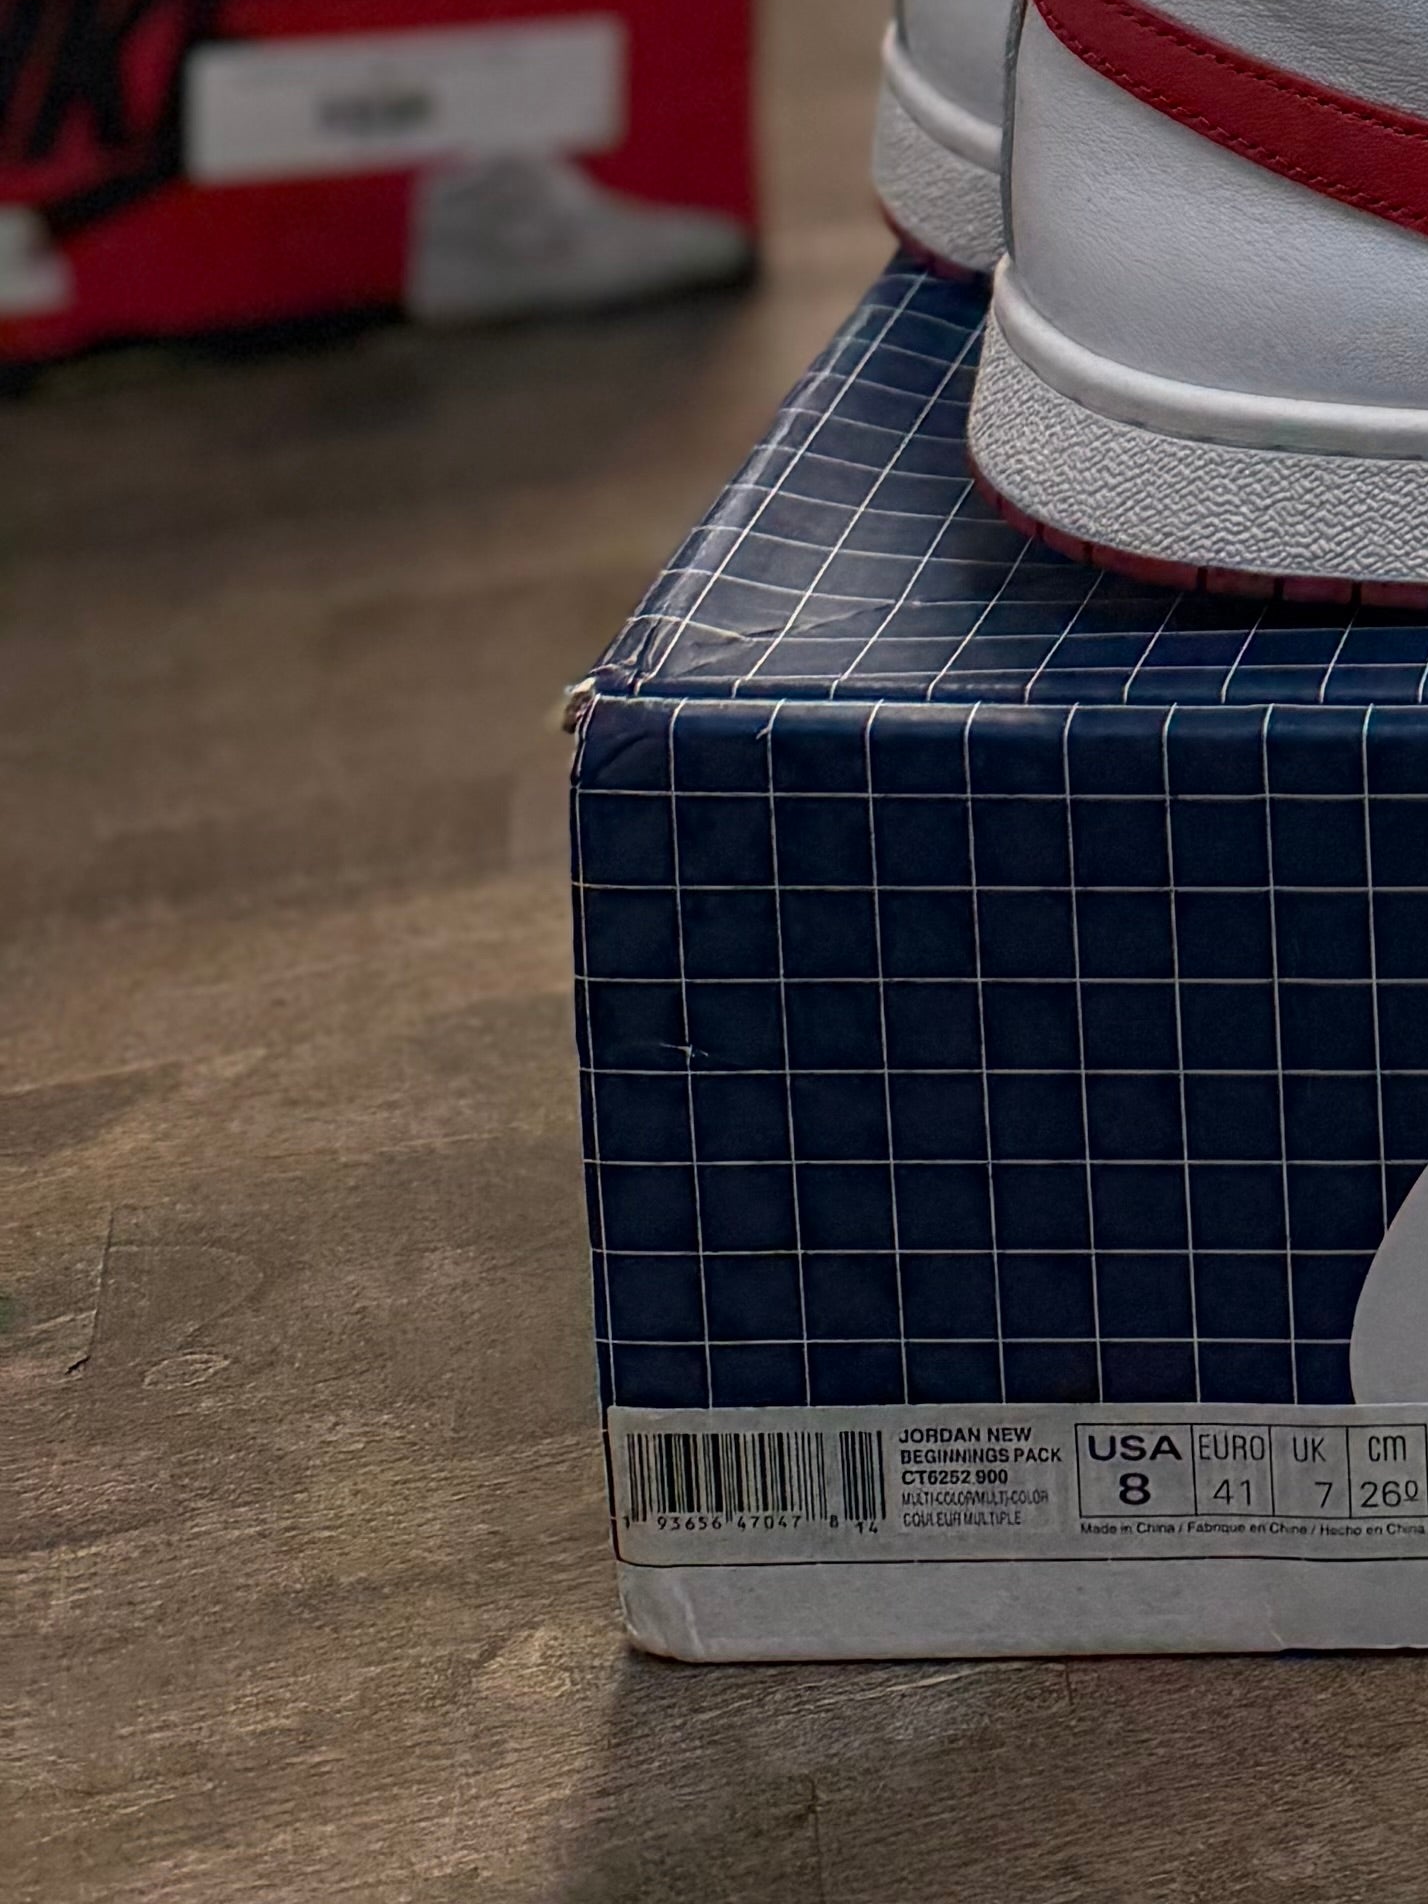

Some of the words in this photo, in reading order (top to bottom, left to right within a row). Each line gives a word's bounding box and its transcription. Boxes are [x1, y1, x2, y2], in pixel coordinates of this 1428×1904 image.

[899, 1427, 981, 1444] JORDAN
[987, 1427, 1032, 1442] NEW
[1088, 1435, 1182, 1461] USA
[1199, 1434, 1265, 1461] EURO
[1368, 1434, 1407, 1462] cm
[901, 1448, 1010, 1464] BEGINNINGS
[1014, 1448, 1062, 1463] PACK
[1293, 1436, 1327, 1463] UK
[1119, 1472, 1151, 1506] 8
[1213, 1478, 1251, 1506] 41
[1314, 1481, 1333, 1508] 7
[657, 1515, 722, 1530] 93656
[737, 1515, 802, 1529] 47047
[855, 1518, 879, 1533] 14
[1080, 1522, 1117, 1535] Made
[1120, 1522, 1132, 1534] in
[1136, 1522, 1175, 1534] China
[1250, 1524, 1266, 1534] en
[1269, 1522, 1307, 1534] Chine
[1320, 1523, 1362, 1535] Hecho
[1366, 1525, 1383, 1535] en
[1386, 1523, 1425, 1535] China
